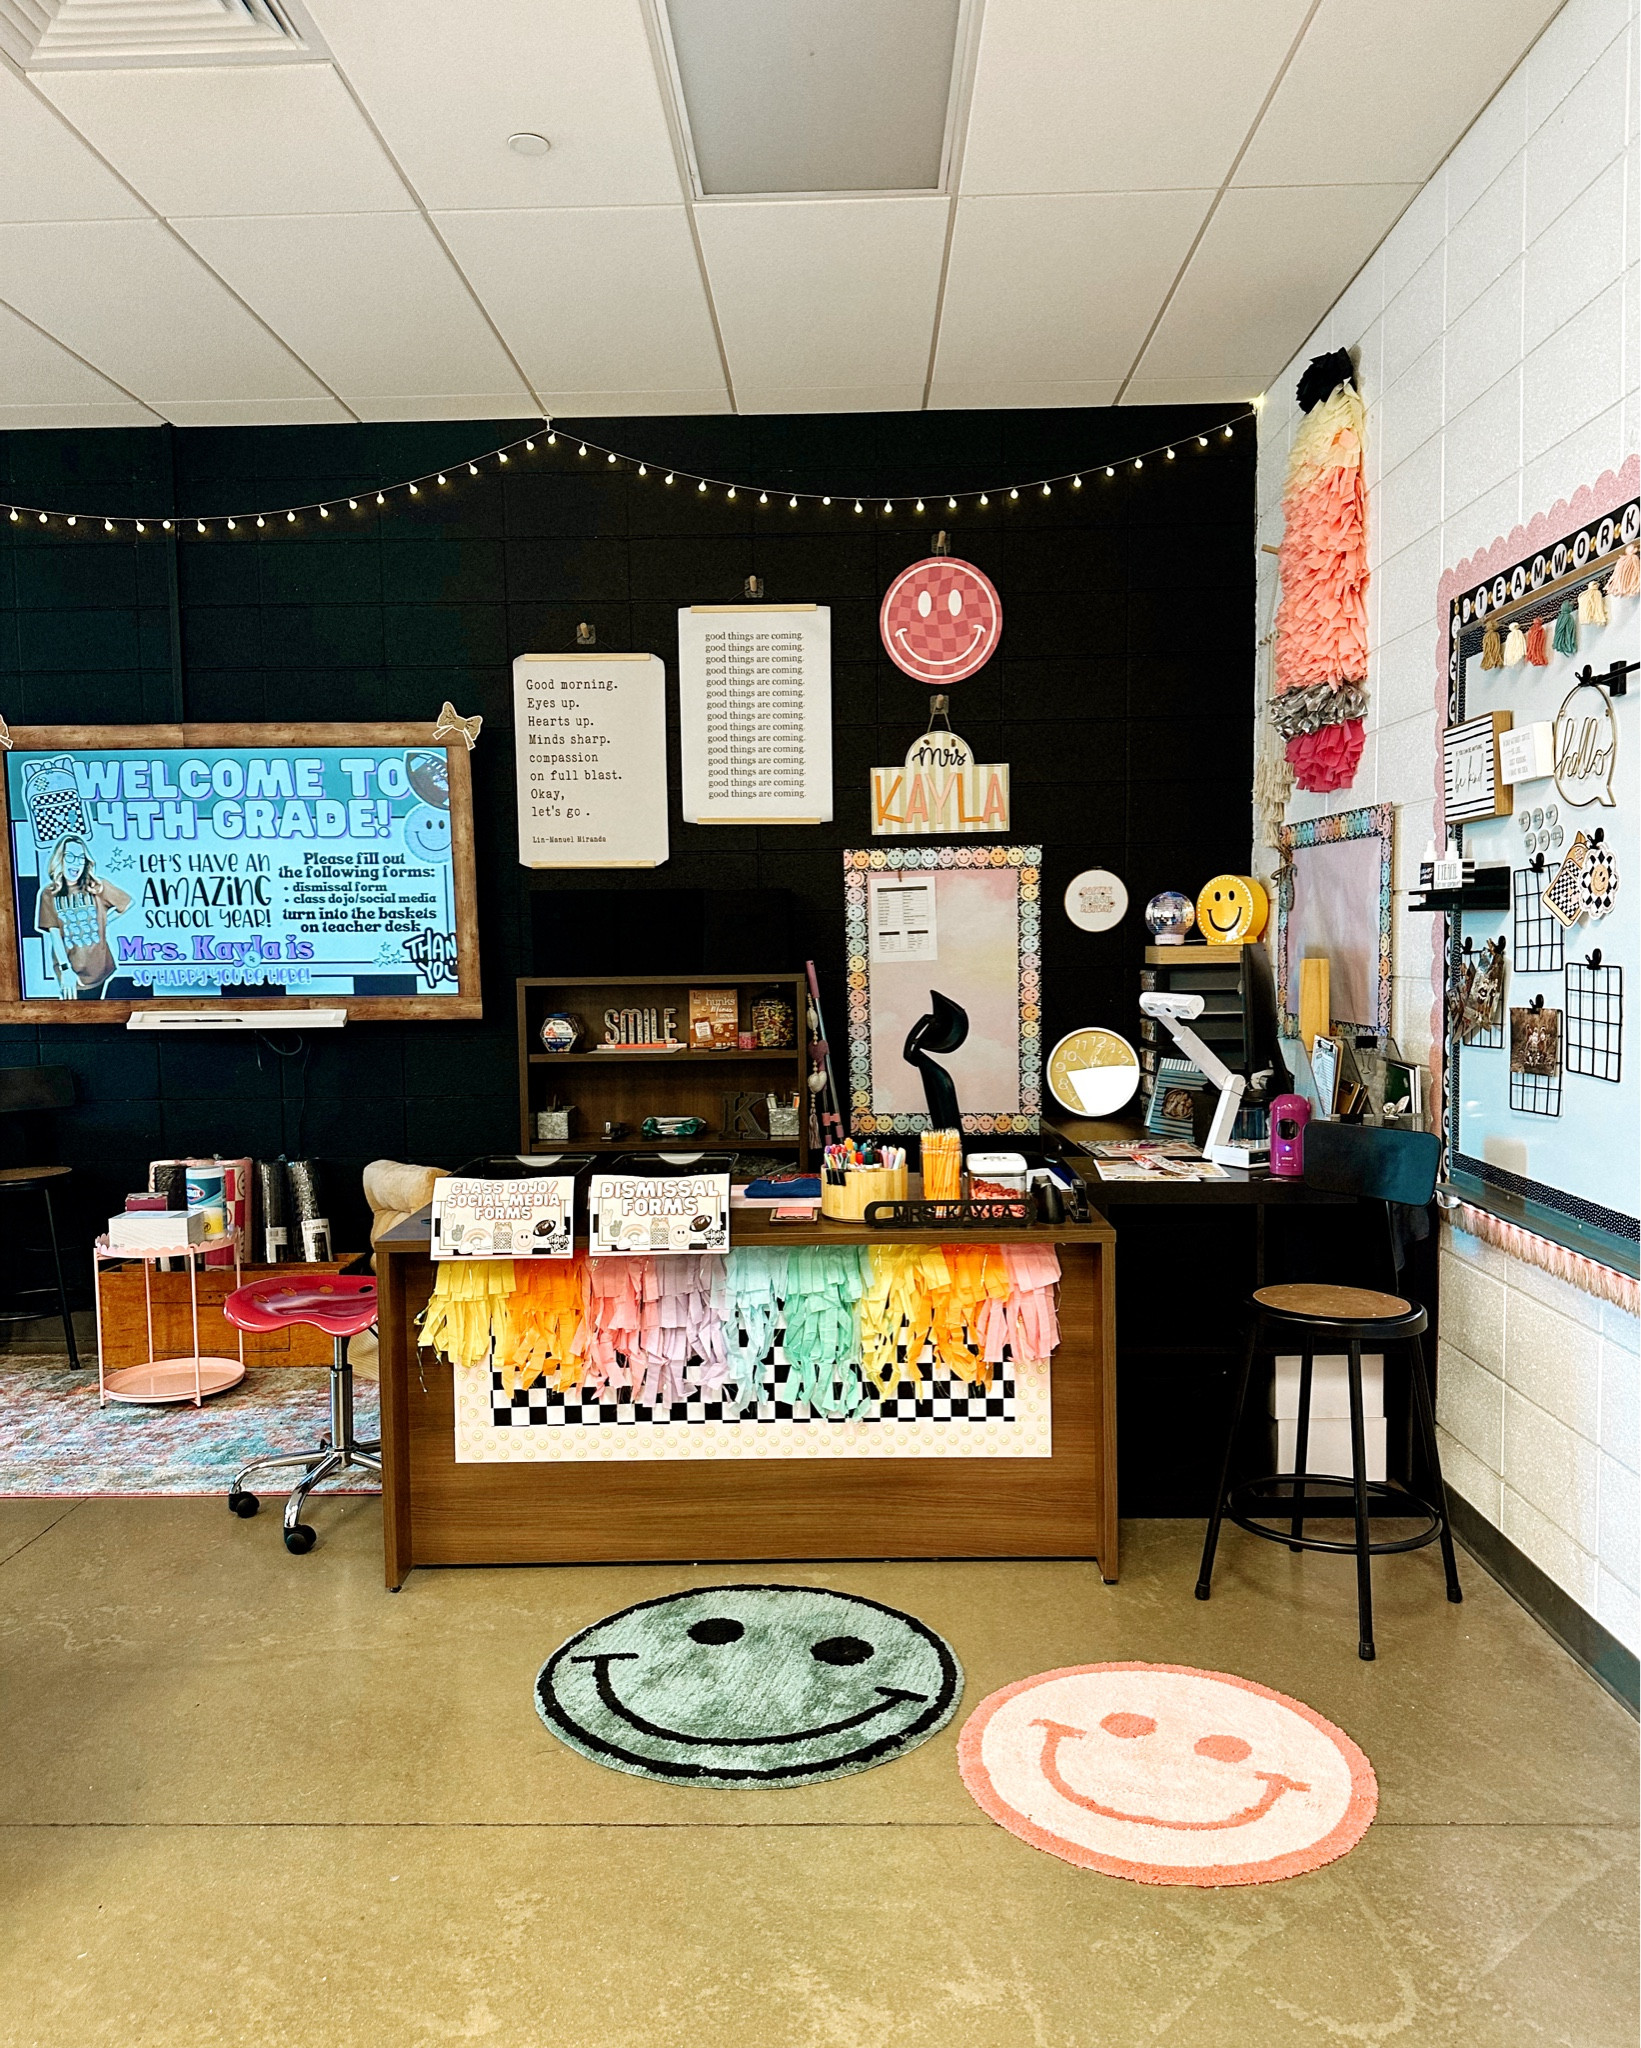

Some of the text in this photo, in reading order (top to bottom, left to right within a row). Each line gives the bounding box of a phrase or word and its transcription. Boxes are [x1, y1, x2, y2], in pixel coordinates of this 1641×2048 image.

[1478, 509, 1636, 610] TEAMWORK
[705, 632, 726, 642] good
[728, 632, 754, 641] things
[705, 643, 726, 653] good
[728, 643, 754, 653] things
[706, 655, 726, 664] good
[728, 654, 754, 664] things
[706, 666, 726, 675] good
[729, 666, 755, 675] things
[526, 679, 617, 691] Good morning.
[706, 677, 726, 687] good
[729, 677, 755, 686] things
[706, 688, 727, 698] good
[729, 688, 755, 698] things
[527, 698, 579, 710] Eyes up.
[706, 700, 727, 709] good
[729, 699, 755, 709] things
[528, 716, 594, 728] Hearts up.
[707, 711, 727, 721] good
[730, 711, 755, 720] things
[707, 722, 727, 732] good
[730, 722, 755, 732] things
[529, 734, 610, 746] Minds sharp.
[707, 734, 727, 743] good
[730, 733, 756, 743] things
[708, 745, 728, 754] good
[730, 745, 756, 754] things
[529, 752, 598, 765] compassion
[708, 756, 728, 766] good
[730, 756, 756, 765] things
[530, 770, 622, 781] on full blast.
[708, 767, 728, 777] good
[731, 767, 756, 777] things
[758, 767, 772, 775] are
[72, 757, 409, 800] WELCOME TO
[708, 779, 728, 788] good
[731, 778, 756, 788] things
[531, 788, 564, 800] Okay,
[708, 790, 728, 800] good
[731, 790, 756, 799] things
[875, 773, 1006, 826] KAYLA
[532, 805, 561, 816] let's
[97, 799, 391, 840] 4TH GRADE!
[304, 853, 405, 864] Please fill out
[279, 866, 435, 880] the following forms:
[293, 882, 387, 892] dismissal form
[293, 893, 436, 906] class dojo/social media
[145, 909, 214, 928] SCHOOL
[283, 907, 437, 920] turn into the baskets
[300, 920, 421, 932] on teacher desk
[117, 934, 314, 967] Mrs. Kayla is
[403, 928, 457, 961] THAN
[134, 968, 152, 985] SO
[705, 997, 735, 1006] hunks
[604, 1007, 678, 1044] SMILE
[1075, 1040, 1087, 1051] 11
[1090, 1036, 1107, 1048] 12
[1062, 1050, 1077, 1062] 10
[1055, 1062, 1066, 1073] 9
[1058, 1078, 1068, 1090] 8
[720, 1091, 769, 1140] K
[451, 1181, 558, 1194] CLASS DOJO/
[601, 1180, 719, 1198] DISMISSAL
[446, 1193, 560, 1208] SOCIAL MEDIA
[622, 1197, 698, 1216] FORMS
[474, 1206, 532, 1220] FORMS
[947, 1204, 1013, 1220] KAYLA
